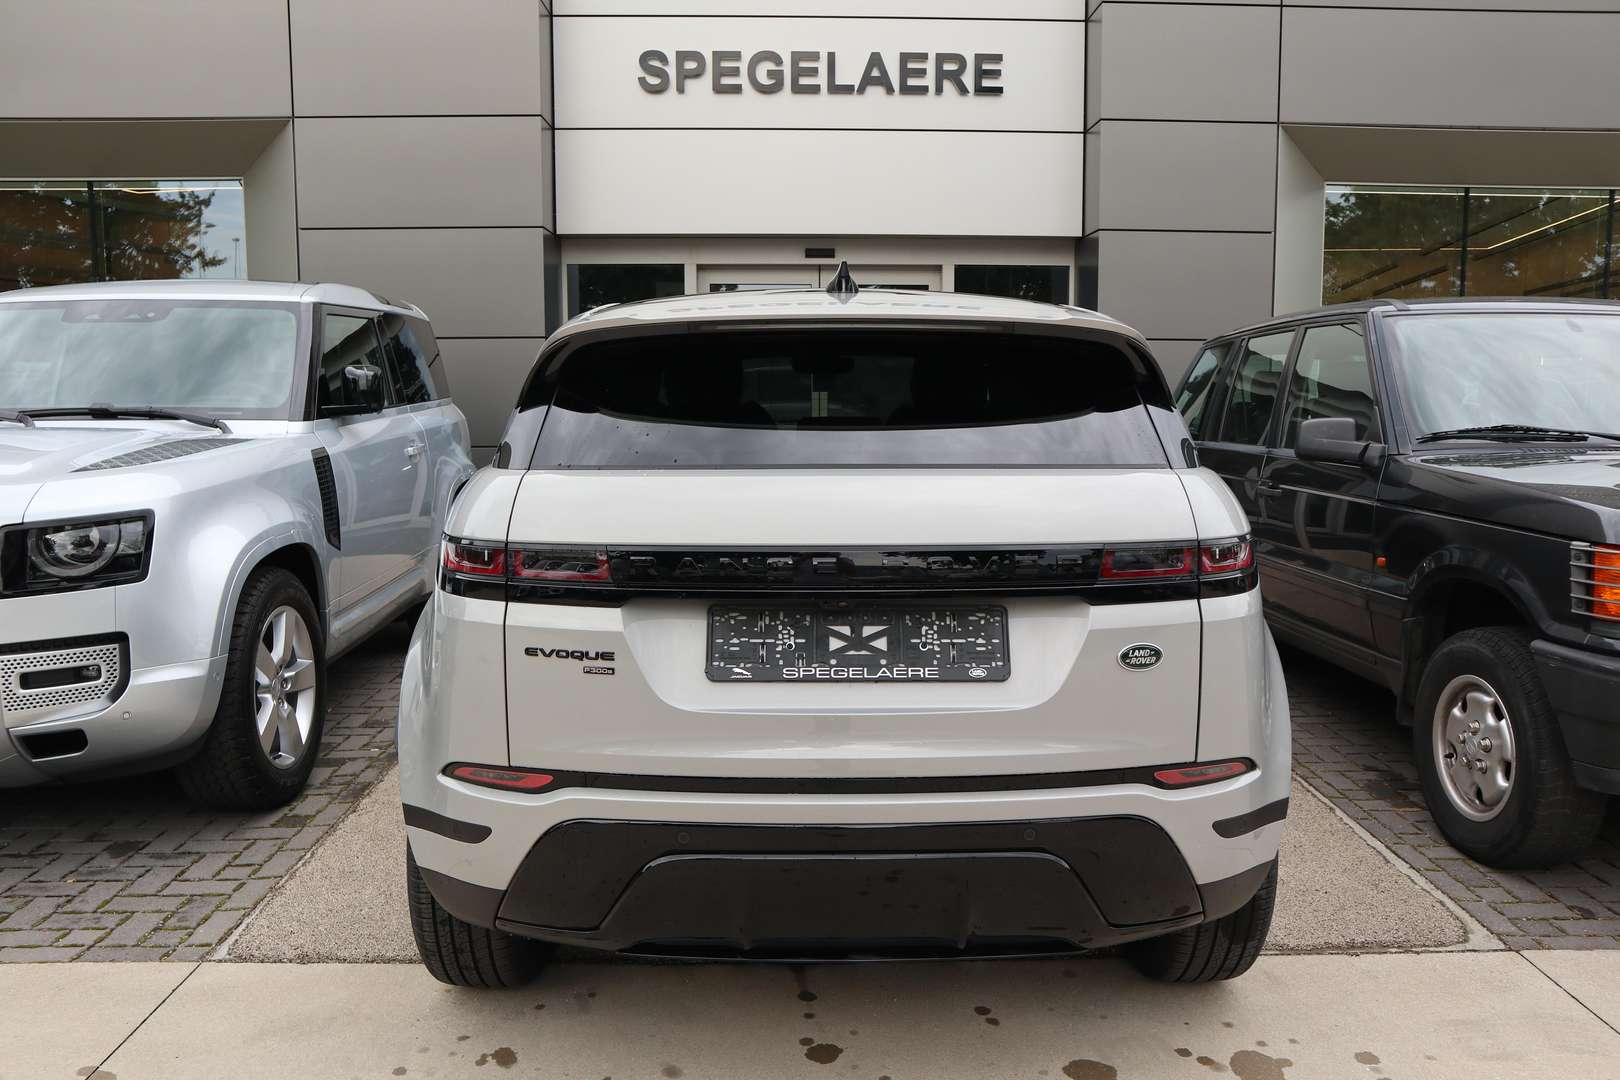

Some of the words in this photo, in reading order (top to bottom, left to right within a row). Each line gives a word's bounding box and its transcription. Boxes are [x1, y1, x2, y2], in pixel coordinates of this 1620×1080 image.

[637, 49, 1004, 96] SPEGELAERE
[524, 646, 615, 661] EVOQUE
[782, 667, 939, 678] SPEGELAERE
